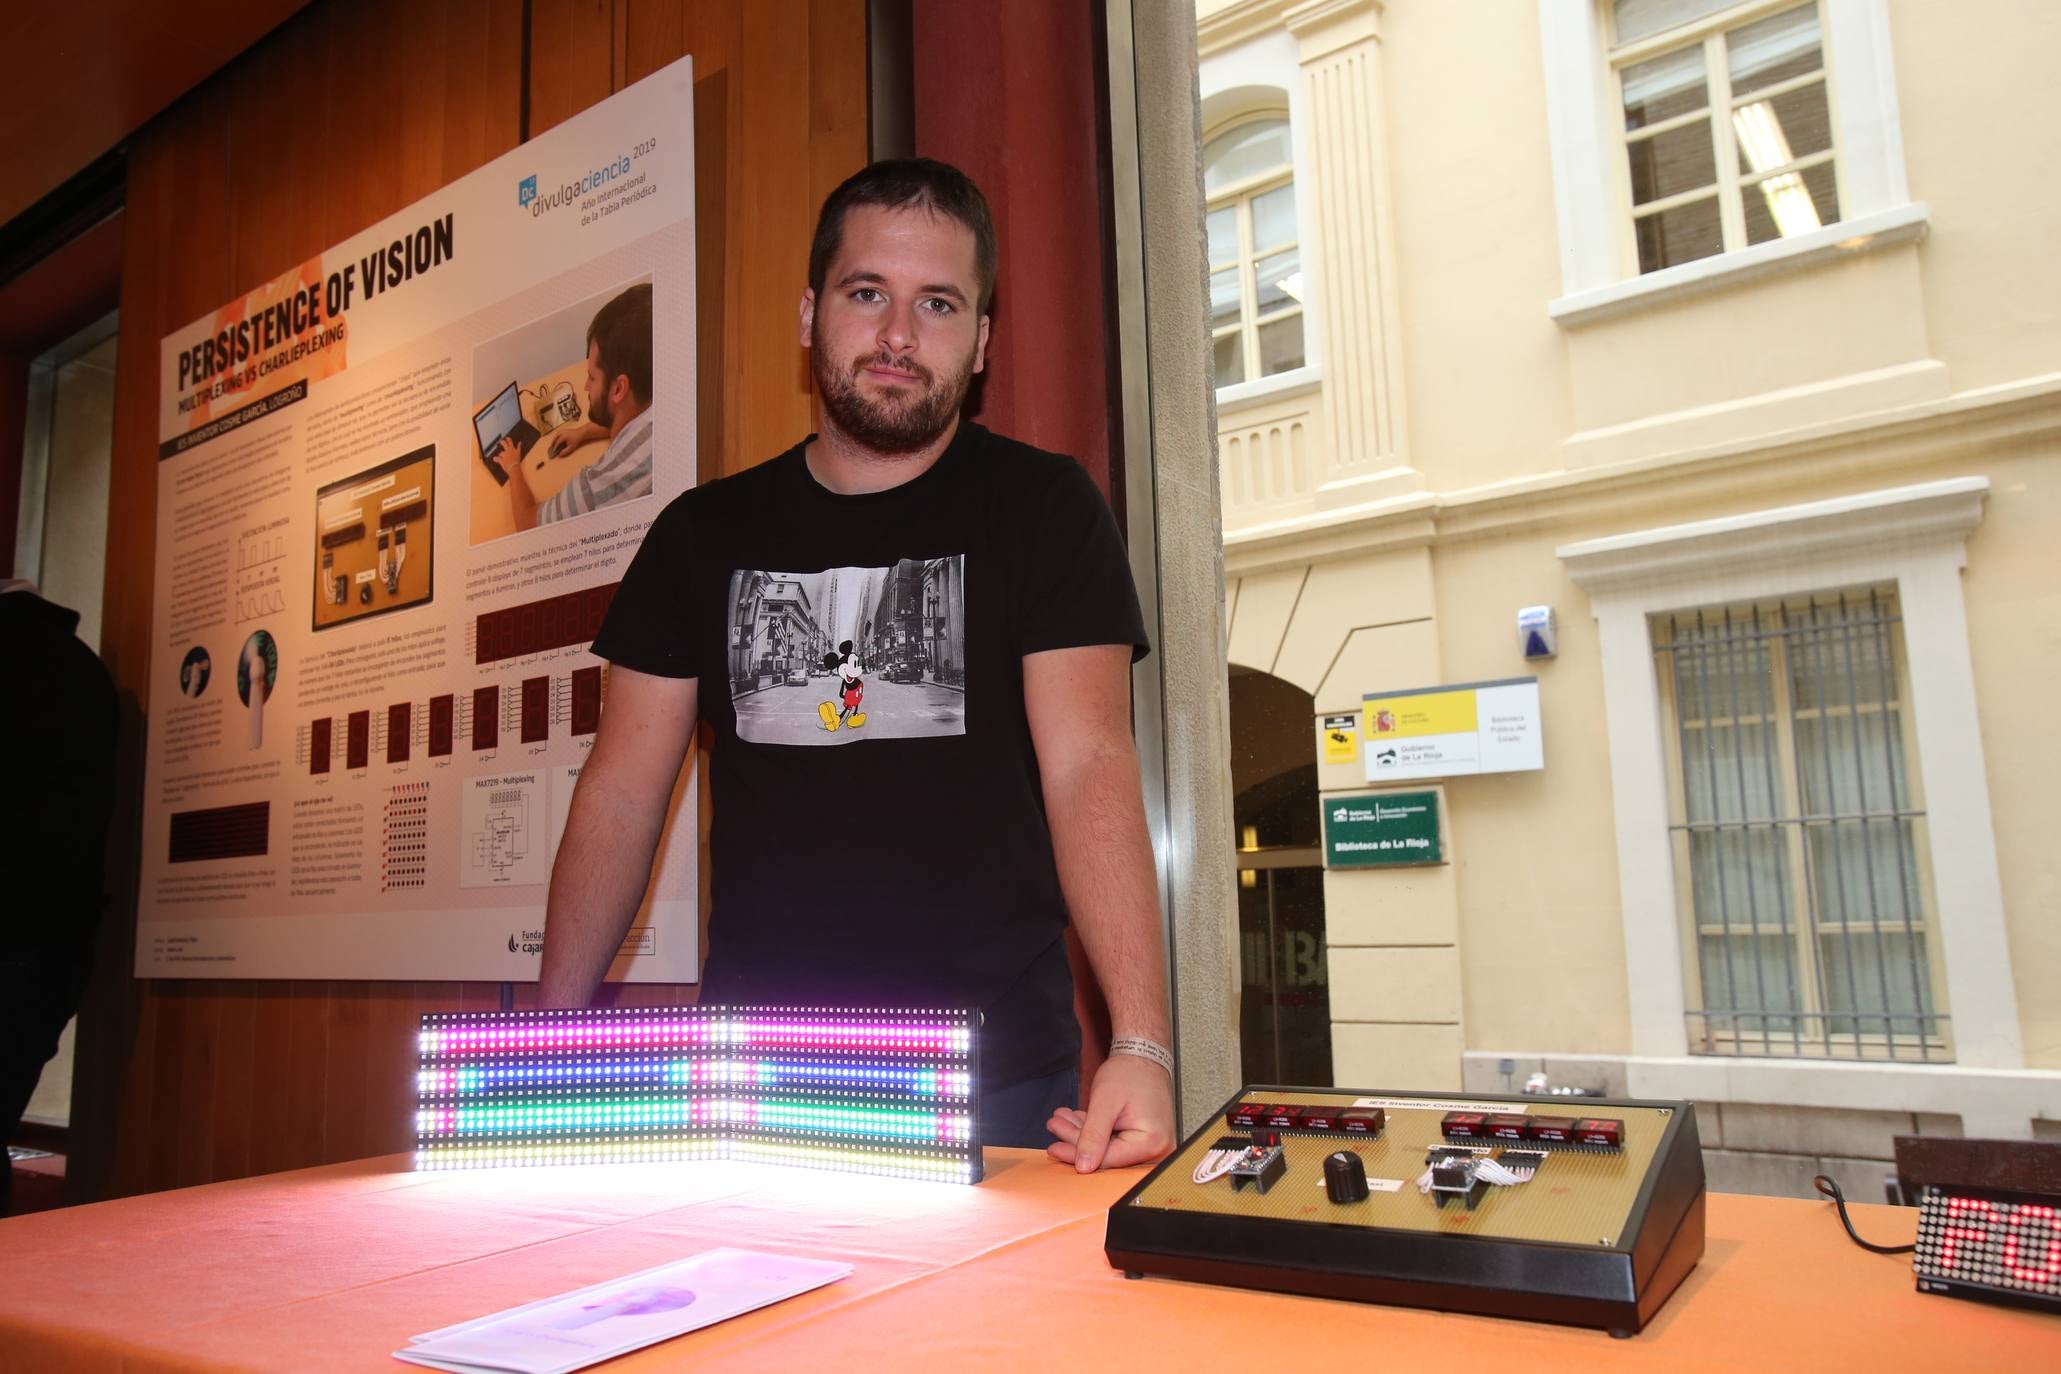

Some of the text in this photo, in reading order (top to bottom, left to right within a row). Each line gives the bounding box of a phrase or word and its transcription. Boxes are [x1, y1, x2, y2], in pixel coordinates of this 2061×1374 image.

[532, 154, 631, 218] divulgaciencia
[632, 137, 657, 160] 2019
[581, 171, 646, 212] Año Internacional
[581, 215, 591, 226] de
[592, 211, 598, 222] la
[600, 201, 620, 217] Tabla
[178, 211, 454, 392] PERSISTENCE OF VISION
[178, 322, 344, 416] MULTIPLEXING VS CHARLIEPLEXING
[1401, 751, 1443, 761] de La Rioja
[503, 775, 535, 786] Multiplexing
[1335, 837, 1430, 852] Biblioteca de La Rioja
